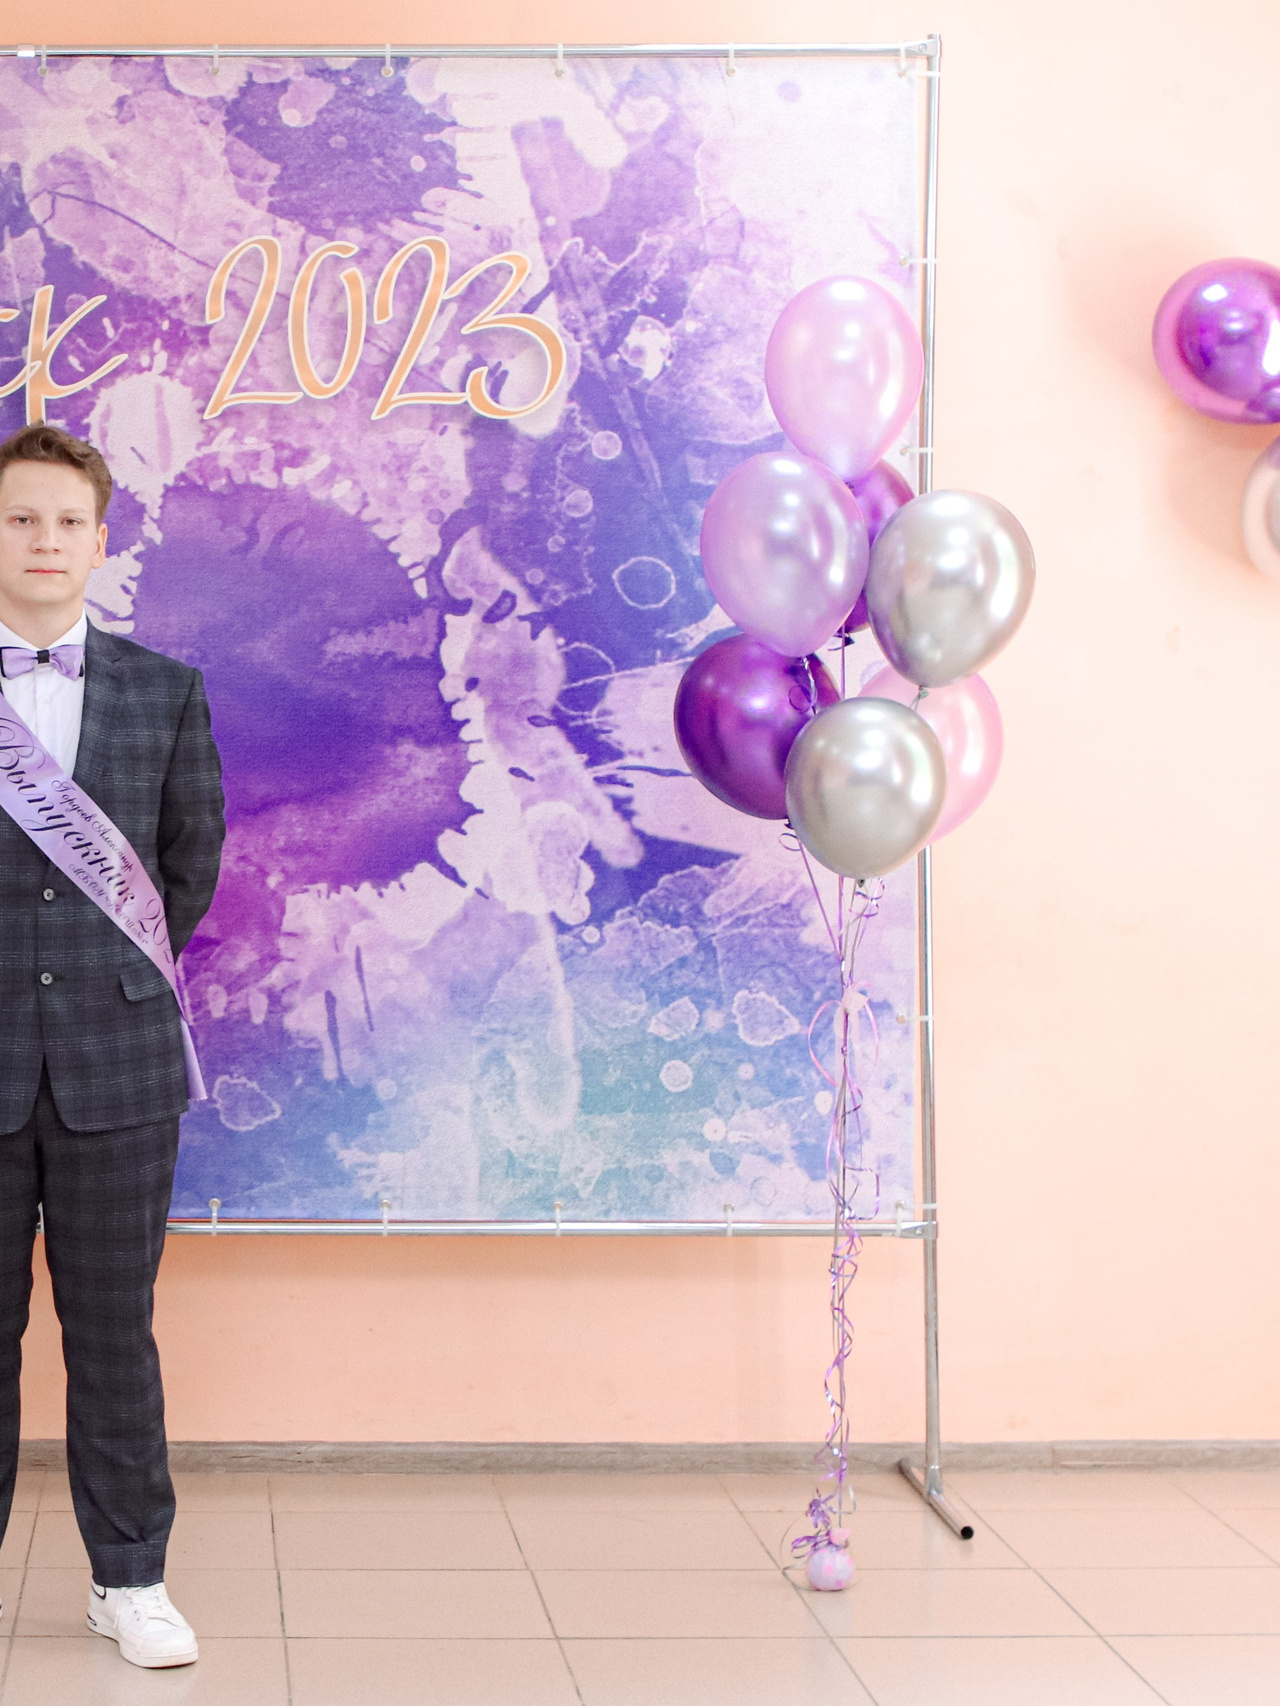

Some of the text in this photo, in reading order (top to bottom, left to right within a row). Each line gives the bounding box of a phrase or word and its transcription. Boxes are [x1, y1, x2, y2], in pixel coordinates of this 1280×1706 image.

[203, 234, 566, 422] 2023
[51, 779, 96, 823] Гордеев
[137, 898, 172, 964] 20
